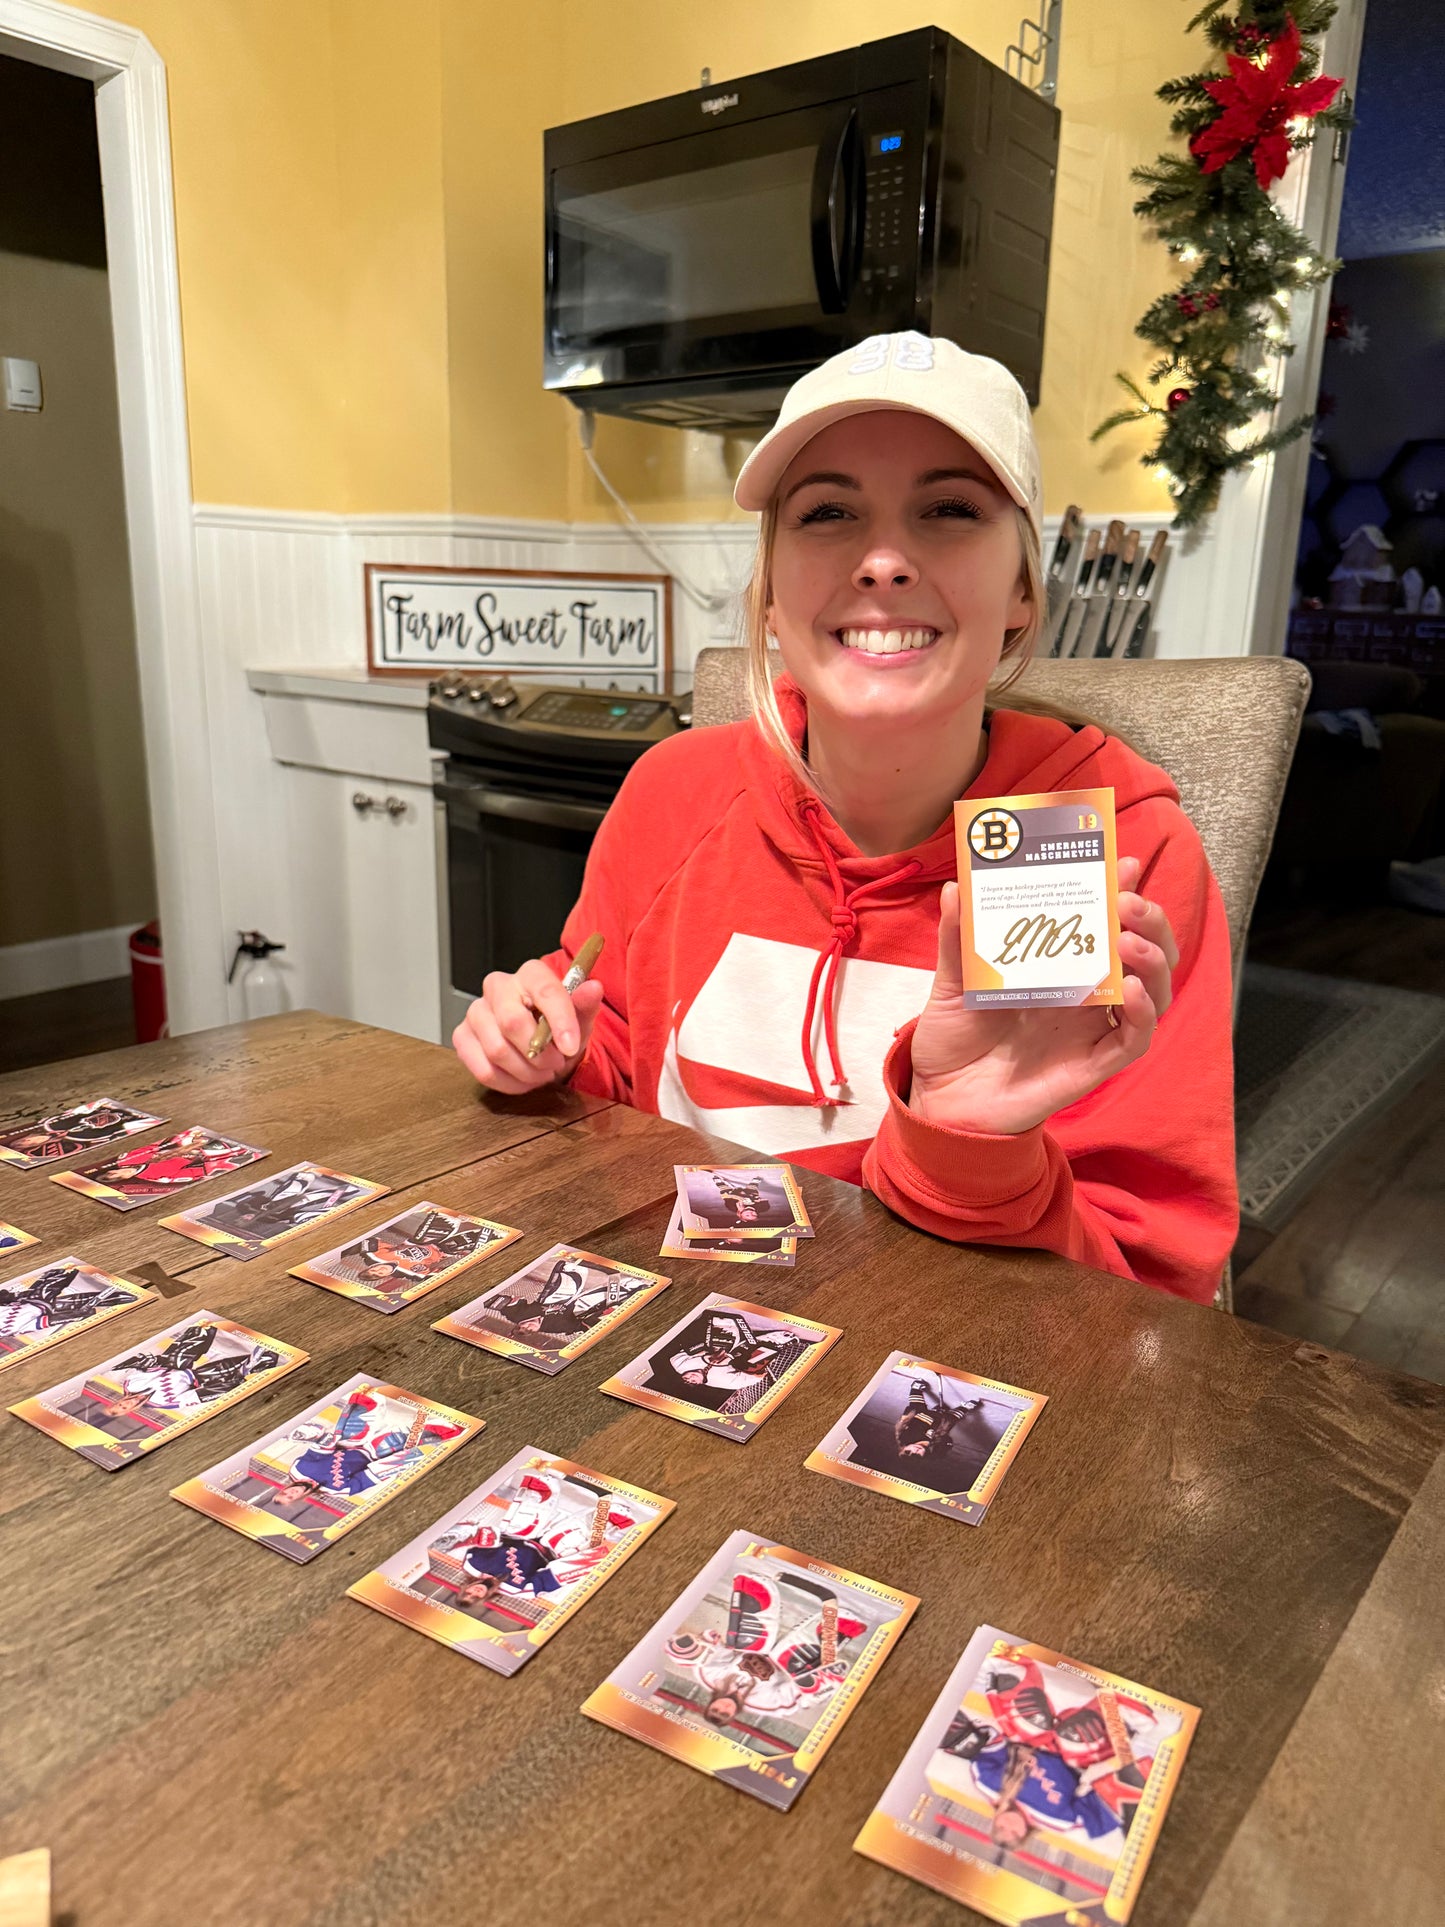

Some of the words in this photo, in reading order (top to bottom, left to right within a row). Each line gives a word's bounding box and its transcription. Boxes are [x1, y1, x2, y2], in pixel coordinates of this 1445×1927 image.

[387, 594, 472, 654] Farm
[474, 592, 566, 656] Sweet
[571, 601, 653, 658] Farm
[1078, 814, 1097, 829] 19
[983, 821, 1007, 850] B
[1041, 840, 1098, 851] EMERANCE
[1026, 849, 1098, 861] MASCHMEYER
[1020, 892, 1040, 900] played
[572, 1470, 641, 1500] SASKATCHEWAN
[639, 1496, 664, 1509] FORT
[805, 1562, 850, 1584] ALBERTA
[849, 1580, 906, 1605] NORTHERN
